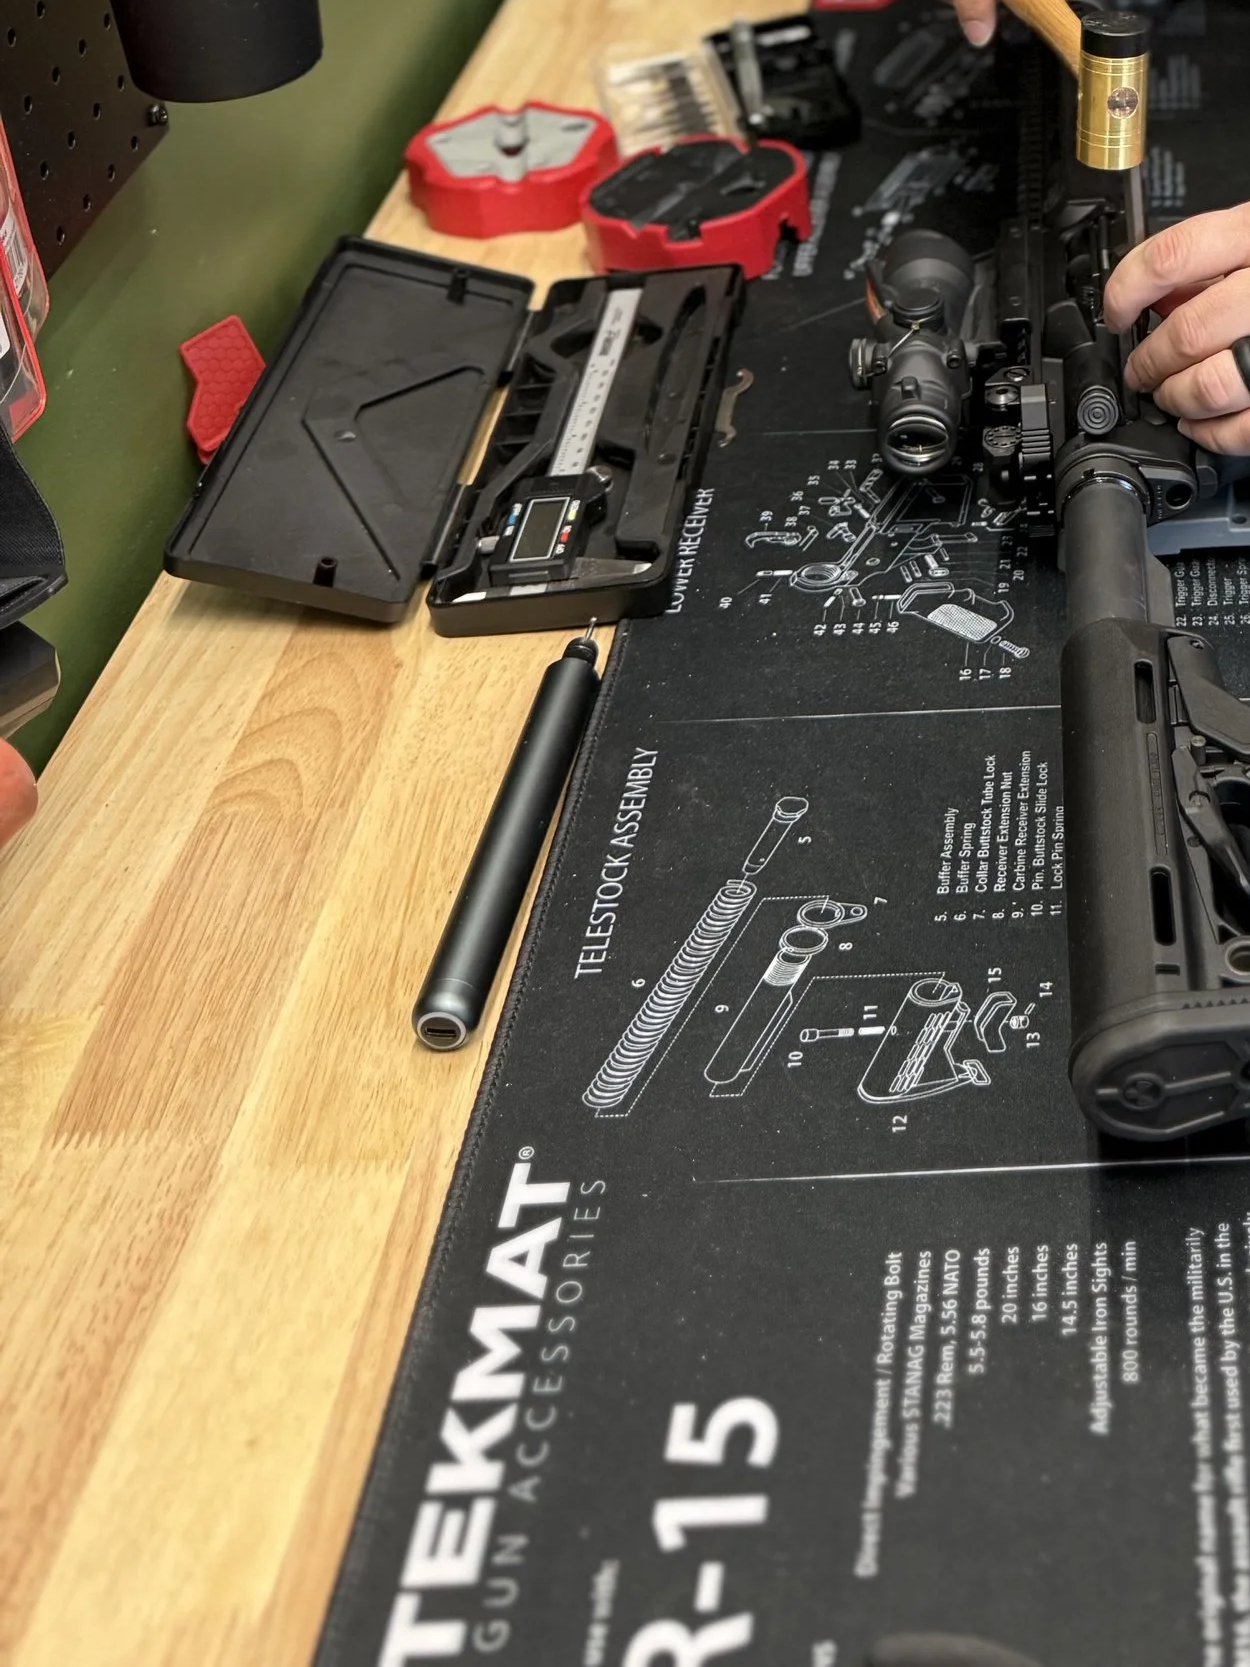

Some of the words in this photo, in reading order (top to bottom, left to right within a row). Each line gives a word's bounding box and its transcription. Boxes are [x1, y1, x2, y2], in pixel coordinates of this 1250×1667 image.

[678, 488, 715, 556] RECEIVER
[984, 755, 996, 779] Lock
[1001, 772, 1013, 790] Nut
[1018, 750, 1031, 800] Extension
[1036, 762, 1048, 786] Lock
[981, 781, 994, 806] Tube
[1035, 790, 1048, 814] Slide
[941, 808, 960, 858] Assembly
[977, 808, 992, 858] Buttstock
[997, 791, 1012, 842] Extension
[1015, 802, 1028, 846] Receiver
[798, 836, 812, 844] 5
[959, 822, 976, 858] Spring
[1033, 816, 1046, 866] Buttstock
[1051, 842, 1064, 860] Pin
[574, 853, 632, 979] TELESTOCK
[610, 747, 658, 848] ASSEMBLY
[937, 862, 952, 894] Buffer
[956, 860, 970, 894] Buffer
[975, 861, 989, 893] Collar
[994, 846, 1008, 892] Receiver
[1012, 849, 1027, 890] Carbine
[1051, 864, 1064, 890] Lock
[874, 897, 888, 906] 7
[934, 911, 948, 922] 5.
[954, 910, 967, 921] 6.
[973, 910, 986, 920] 7.
[992, 909, 1005, 920] 8.
[1031, 900, 1044, 917] 10.
[1050, 900, 1062, 916] 11.
[838, 942, 853, 951] 8
[631, 977, 646, 988] 6
[988, 967, 1002, 983] 15
[1040, 982, 1053, 998] 14
[715, 1004, 729, 1013] 9
[864, 1005, 878, 1020] 11
[1026, 1032, 1040, 1048] 13
[787, 1050, 803, 1068] 10
[892, 1114, 908, 1132] 12
[1214, 1223, 1232, 1249] the
[884, 1251, 903, 1286] Bolt
[943, 1249, 961, 1295] NATO
[1002, 1246, 1021, 1298] inches
[1032, 1244, 1050, 1296] inches
[1062, 1243, 1078, 1295] inches
[1090, 1242, 1112, 1293] Sights
[1121, 1240, 1138, 1272] min
[1184, 1227, 1206, 1300] militarily
[1215, 1252, 1232, 1268] in
[910, 1250, 933, 1339] Magazines
[972, 1247, 992, 1310] pounds
[1216, 1271, 1234, 1304] U.S.
[876, 1289, 902, 1364] Rotating
[940, 1299, 958, 1334] 5.56
[1002, 1302, 1018, 1324] 20
[1032, 1300, 1048, 1322] 16
[1061, 1300, 1078, 1336] 14.5
[1091, 1297, 1109, 1332] Iron
[1122, 1286, 1139, 1346] rounds
[1188, 1305, 1206, 1333] the
[1217, 1308, 1236, 1336] the
[968, 1314, 988, 1374] 5.5-5.8
[1219, 1340, 1241, 1362] by
[937, 1339, 959, 1384] Rem,
[1122, 1350, 1140, 1384] 800
[1189, 1336, 1209, 1406] became
[902, 1344, 926, 1419] STANAG
[1090, 1336, 1114, 1434] Adjustable
[1221, 1366, 1241, 1408] used
[473, 1534, 530, 1652] GUN
[509, 1180, 606, 1501] ACCESSORIES
[933, 1389, 954, 1429] .223
